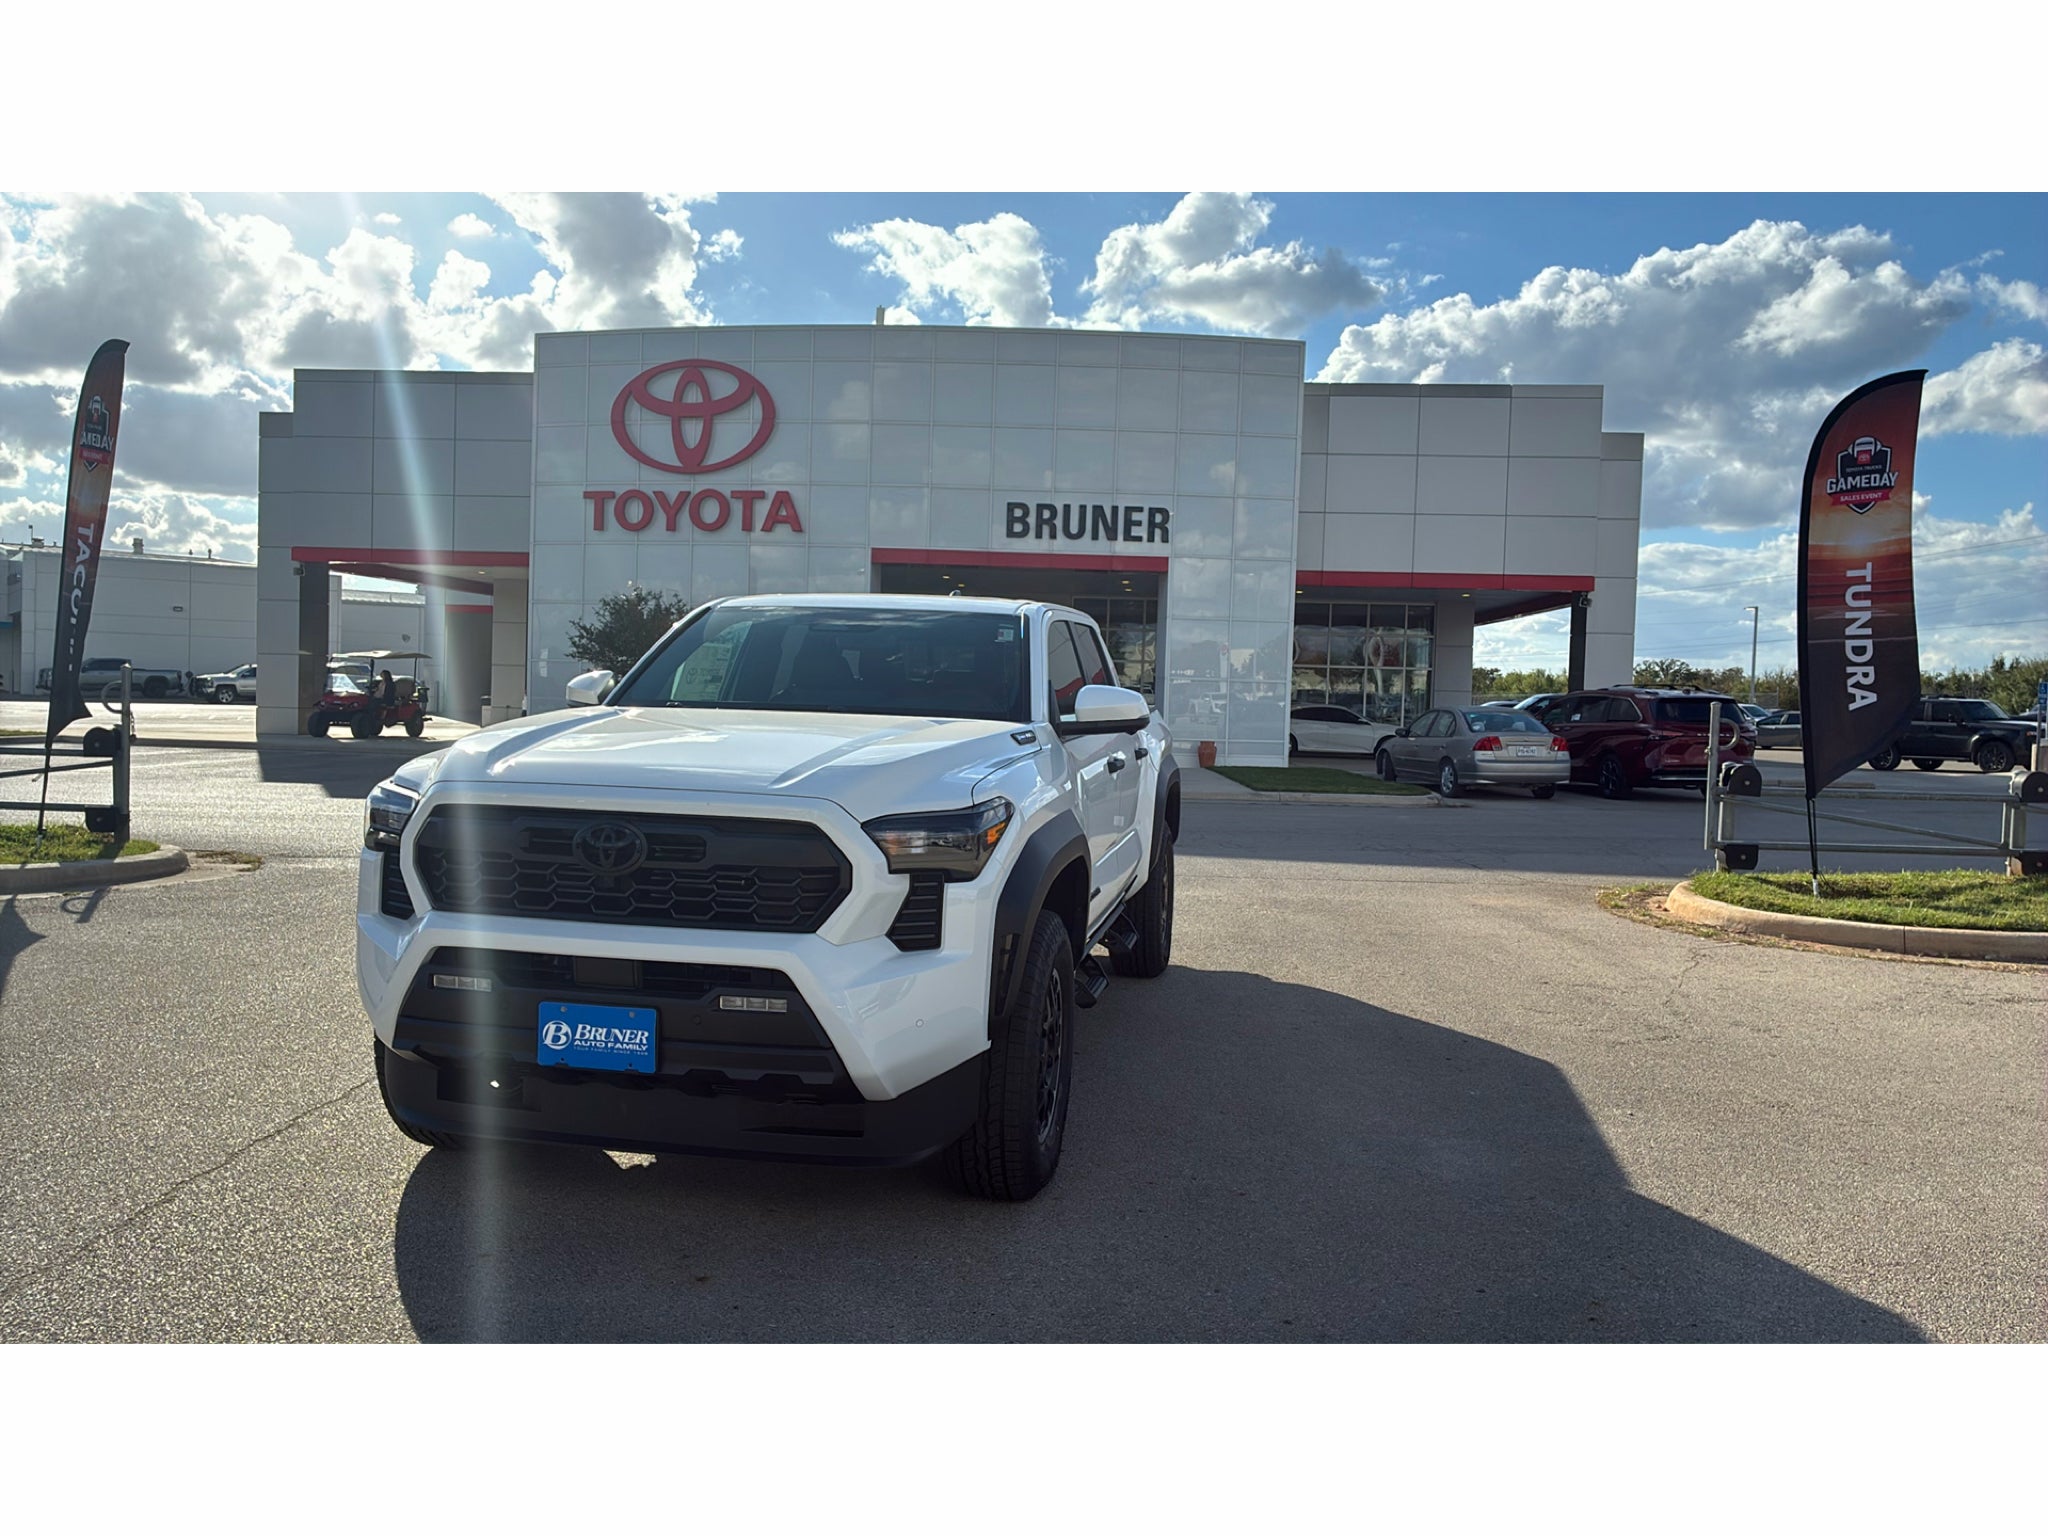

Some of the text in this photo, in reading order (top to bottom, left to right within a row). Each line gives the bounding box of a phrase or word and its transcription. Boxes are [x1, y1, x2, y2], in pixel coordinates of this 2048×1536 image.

[1826, 471, 1899, 494] GAMEDAY
[1860, 492, 1882, 500] EVENT
[583, 489, 803, 533] TOYOTA
[1006, 502, 1171, 544] BRUNER
[1844, 562, 1878, 711] TUNDRA
[574, 1023, 649, 1044] BRUNER
[573, 1040, 648, 1051] AUTO FAMILY
